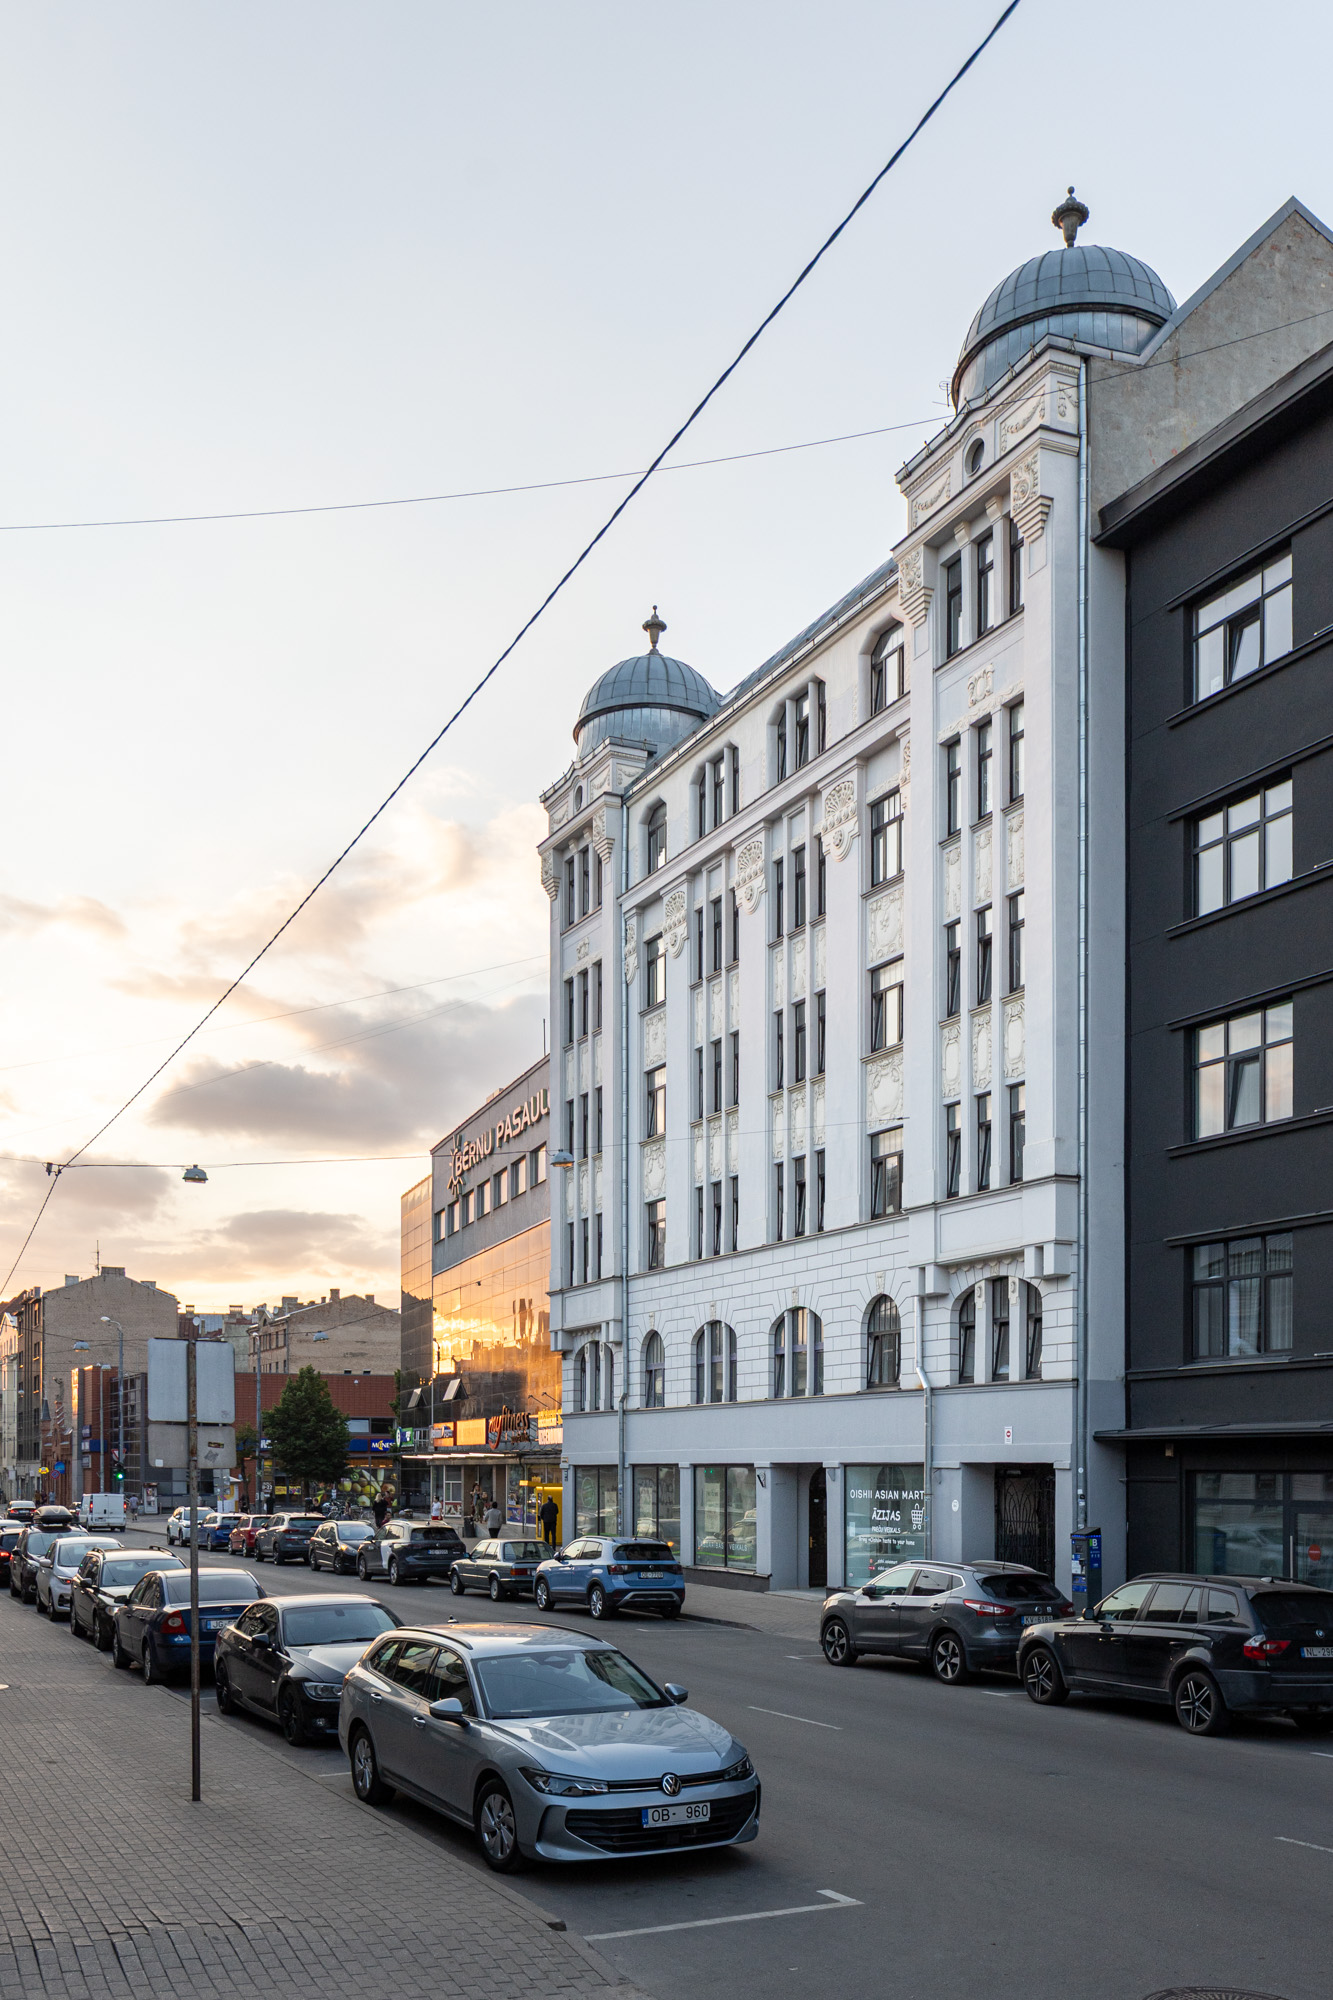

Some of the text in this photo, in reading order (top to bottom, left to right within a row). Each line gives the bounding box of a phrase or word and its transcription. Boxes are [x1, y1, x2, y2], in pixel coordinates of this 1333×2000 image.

[456, 1088, 550, 1177] BĒRNU PASAUL
[850, 1489, 925, 1500] OISHII ASIAN MART
[871, 1507, 901, 1521] ĀZIJAS
[1092, 1538, 1098, 1547] B
